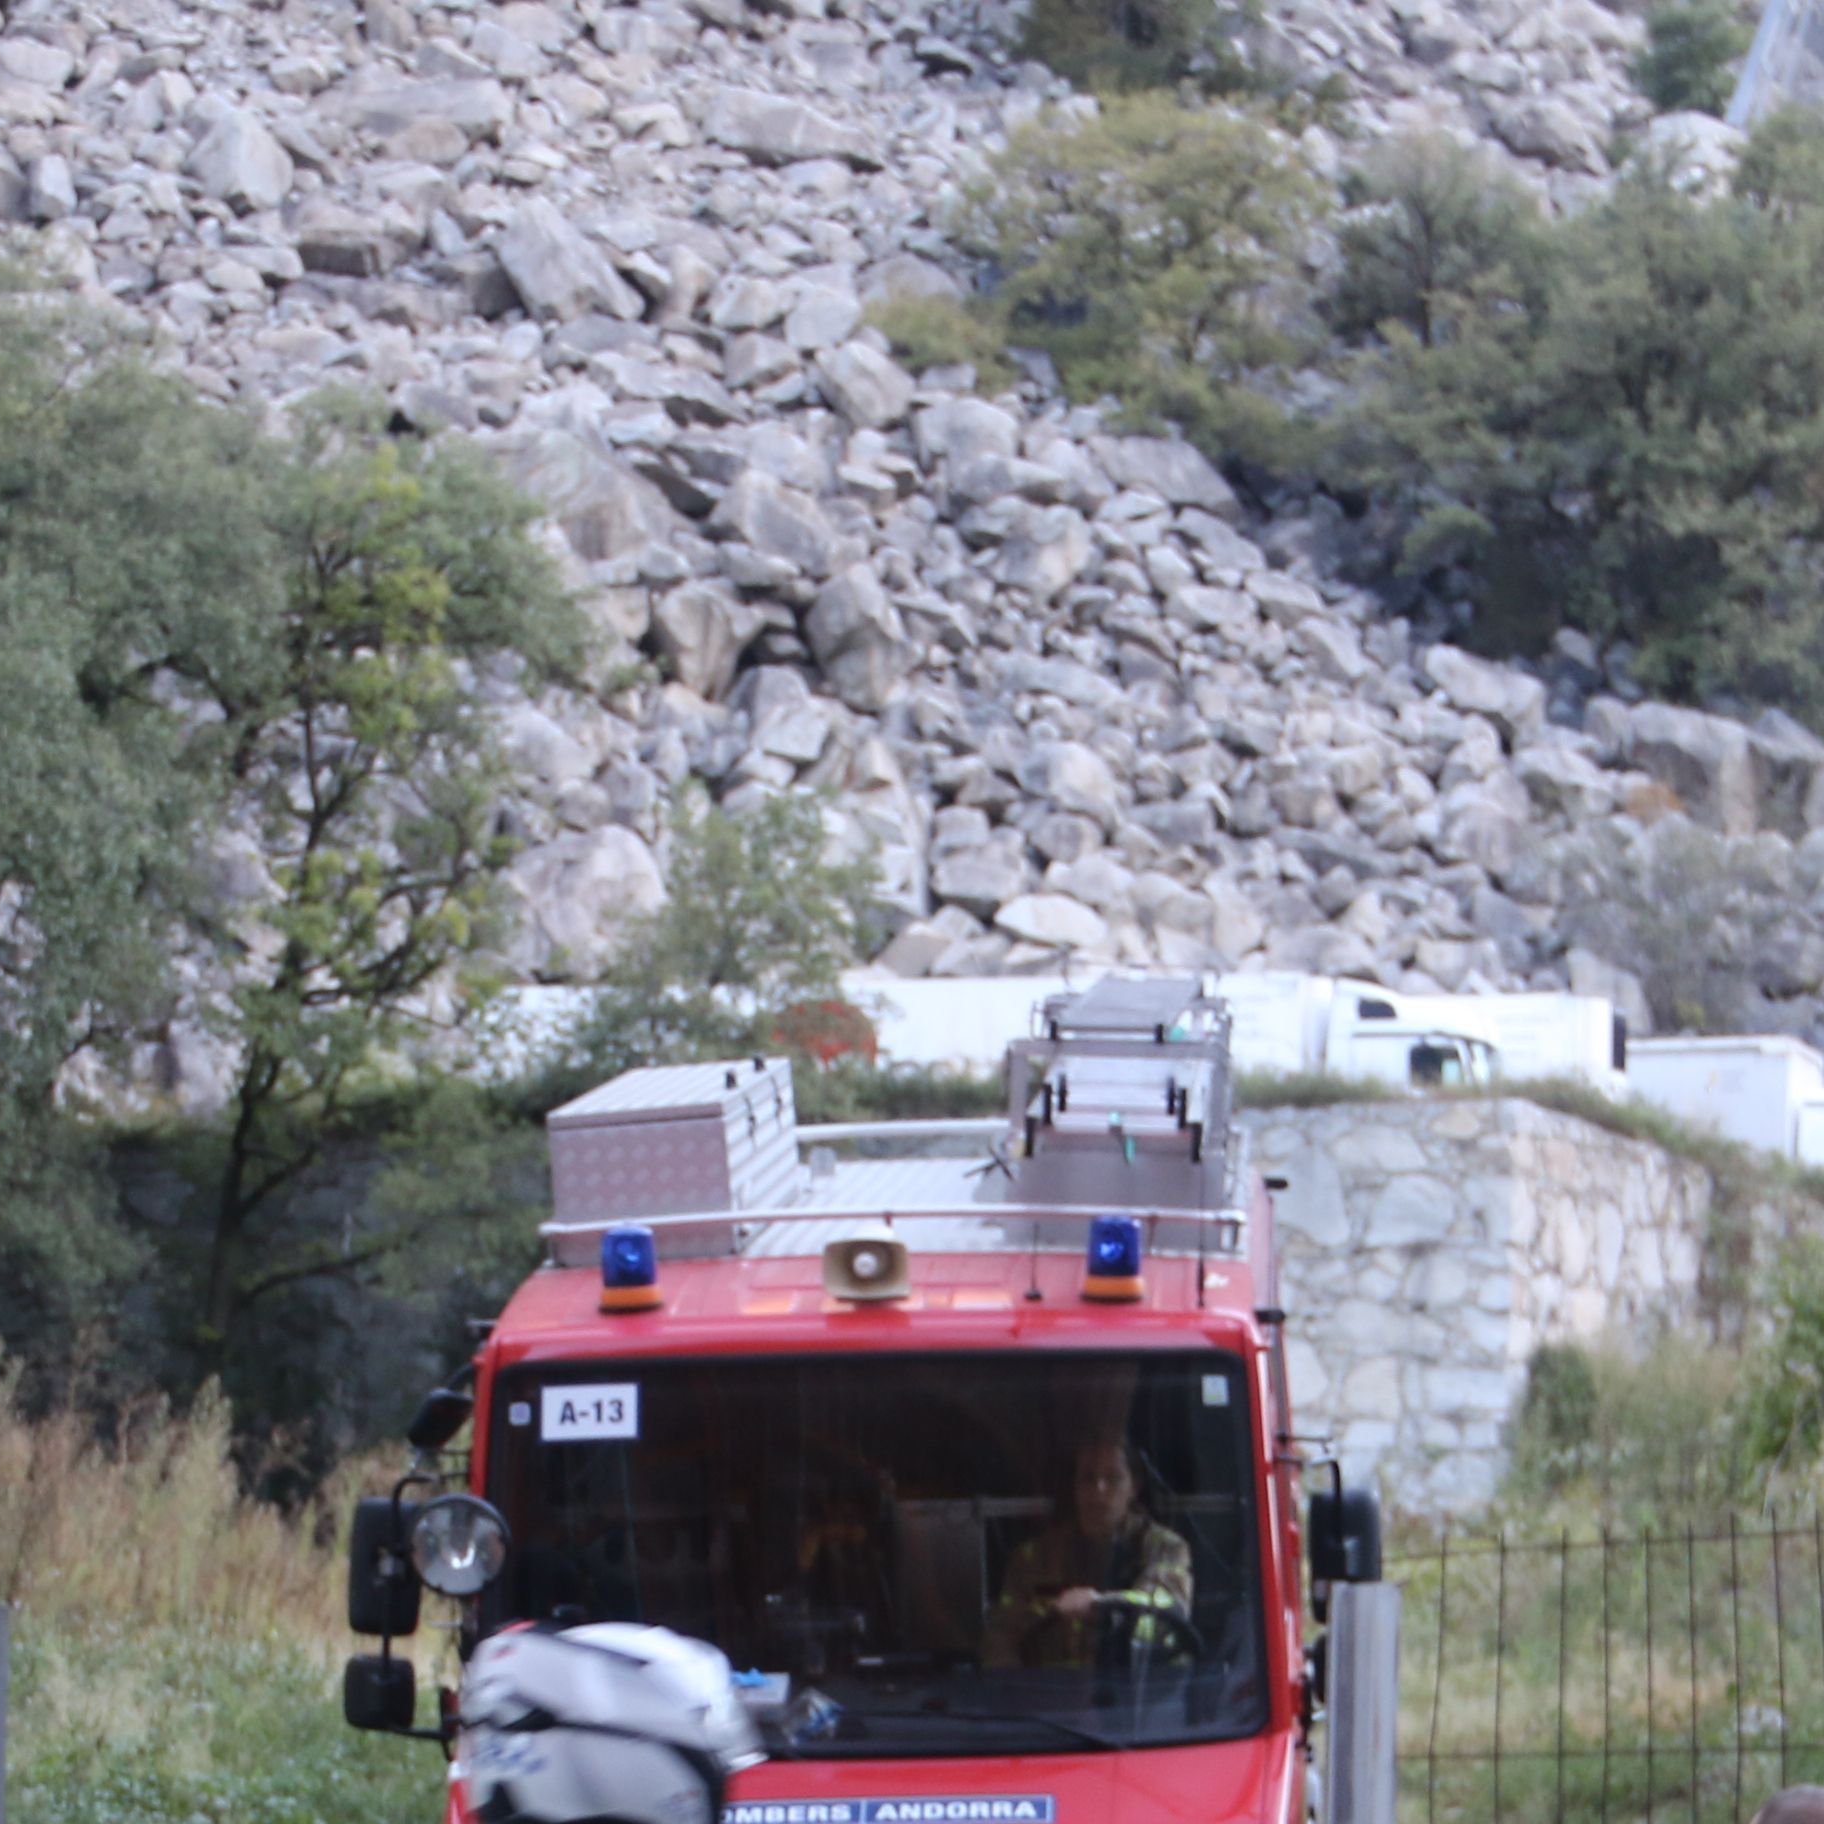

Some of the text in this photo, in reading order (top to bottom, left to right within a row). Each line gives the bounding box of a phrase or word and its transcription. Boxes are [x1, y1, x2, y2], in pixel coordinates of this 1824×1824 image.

[560, 1400, 624, 1425] A-13
[722, 1803, 852, 1824] MBERS
[875, 1801, 1038, 1821] ANDORRA
